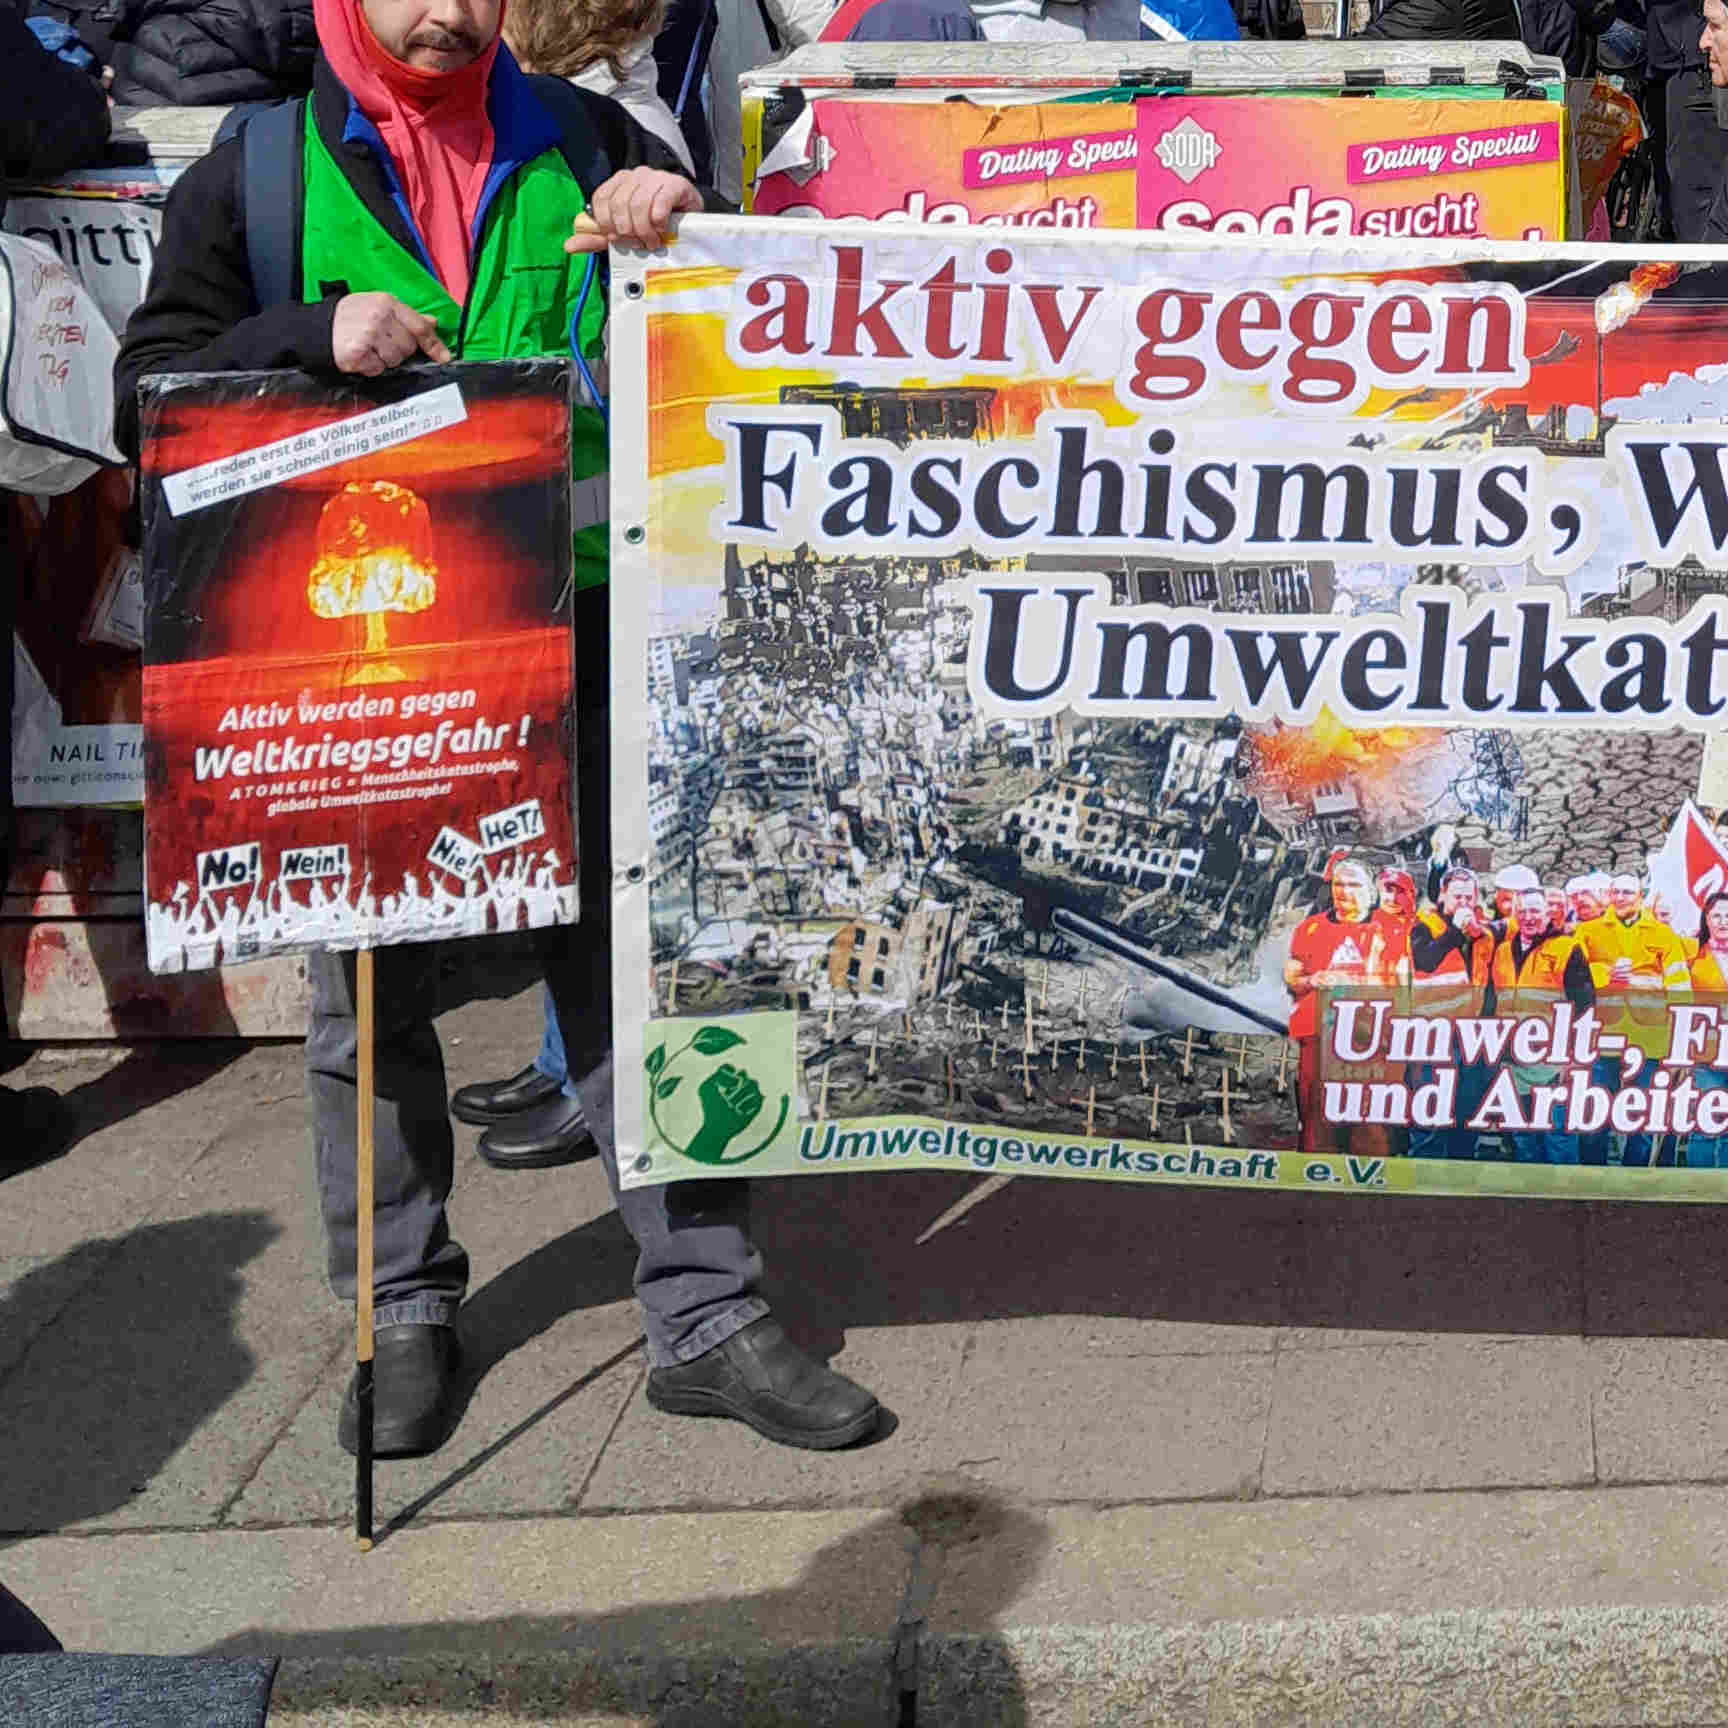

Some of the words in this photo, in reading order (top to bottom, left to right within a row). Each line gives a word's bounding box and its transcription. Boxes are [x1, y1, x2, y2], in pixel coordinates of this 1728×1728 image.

[977, 144, 1063, 180] Dating
[1160, 132, 1217, 170] SODA
[1362, 145, 1446, 178] Dating
[1451, 129, 1541, 162] Special
[1363, 192, 1478, 237] sucht
[738, 246, 1104, 364] aktiv
[1129, 284, 1516, 403] gegen
[726, 420, 1582, 554] Faschismus,
[218, 705, 291, 733] Aktiv
[298, 692, 394, 724] werden
[400, 688, 476, 720] gegen
[50, 743, 105, 763] NAIL
[229, 776, 342, 801] ATOMKRIEG
[267, 794, 319, 817] globale
[202, 847, 259, 886] No!
[284, 848, 346, 876] Nein!
[432, 835, 480, 878] Nie!
[1331, 1000, 1645, 1079] Umwelt-,
[1323, 1068, 1456, 1125] und
[800, 1123, 1277, 1182] Umweltgewerkschaft
